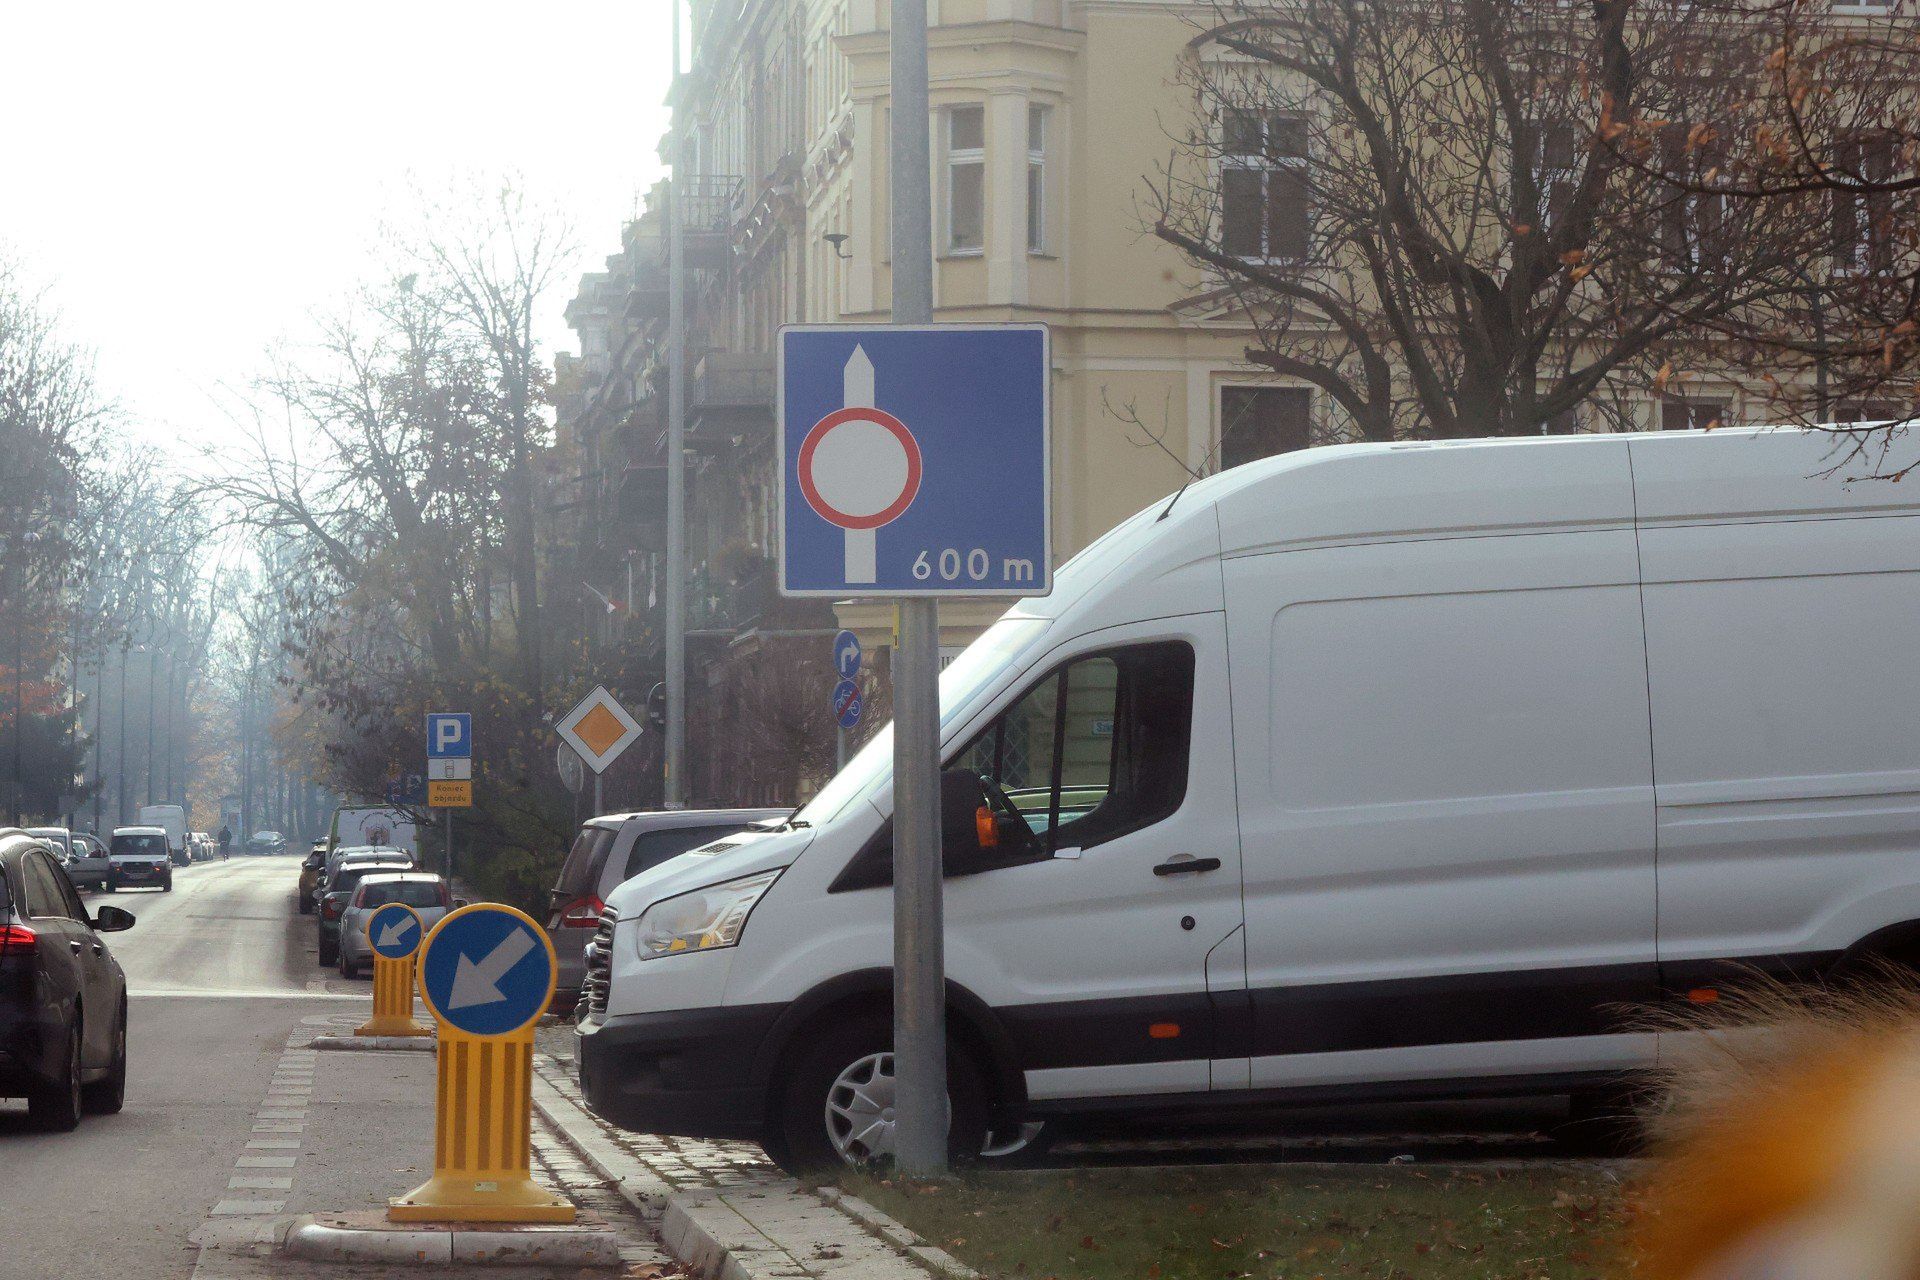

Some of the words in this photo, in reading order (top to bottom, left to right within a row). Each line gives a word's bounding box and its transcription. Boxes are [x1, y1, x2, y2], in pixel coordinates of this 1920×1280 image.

[912, 548, 990, 581] 600
[1003, 558, 1034, 581] m
[436, 719, 462, 752] P
[436, 784, 464, 792] Koniec
